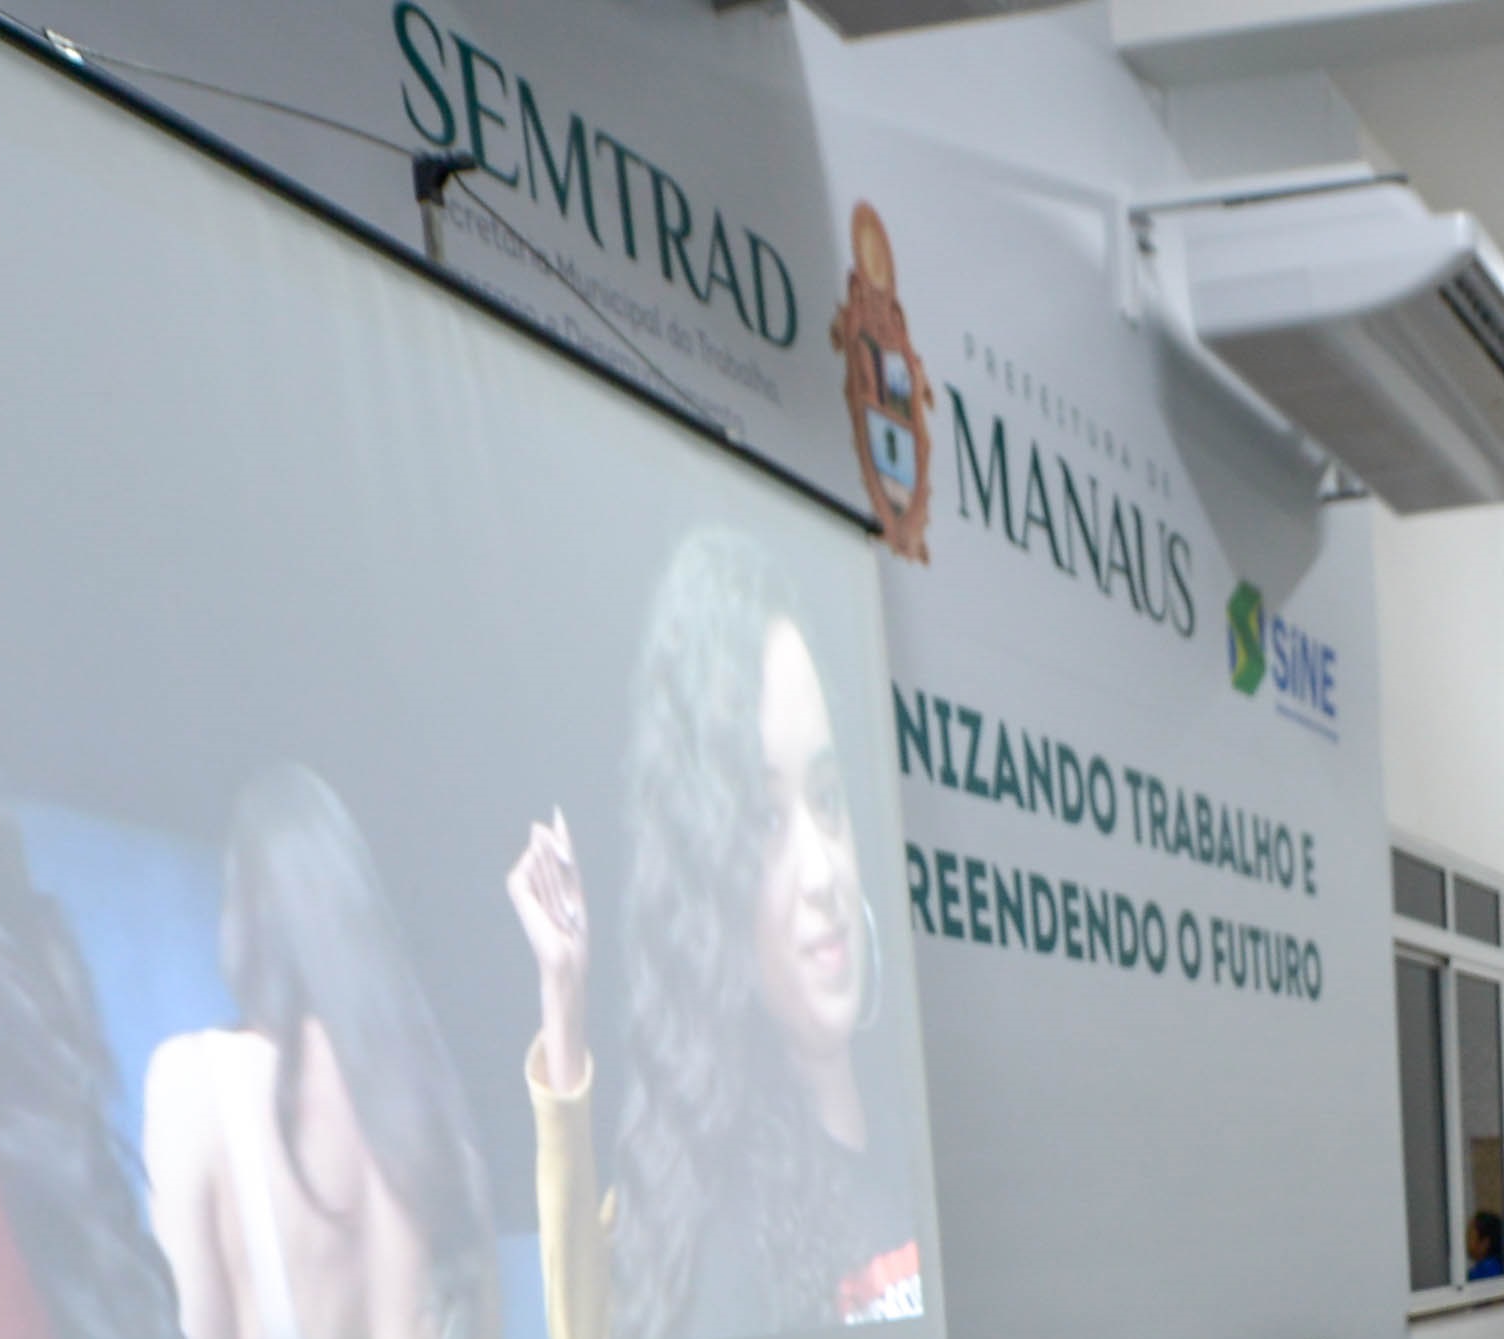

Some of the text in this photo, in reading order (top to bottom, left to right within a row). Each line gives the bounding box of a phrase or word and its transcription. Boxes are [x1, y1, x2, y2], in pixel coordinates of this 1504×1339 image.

[393, 1, 796, 348] SEMTRAD
[945, 382, 1195, 639] MANAUS
[1124, 765, 1295, 890] TRABALHO
[1301, 831, 1317, 897] E
[1178, 908, 1202, 981] O
[1209, 916, 1322, 1001] FUTURO
